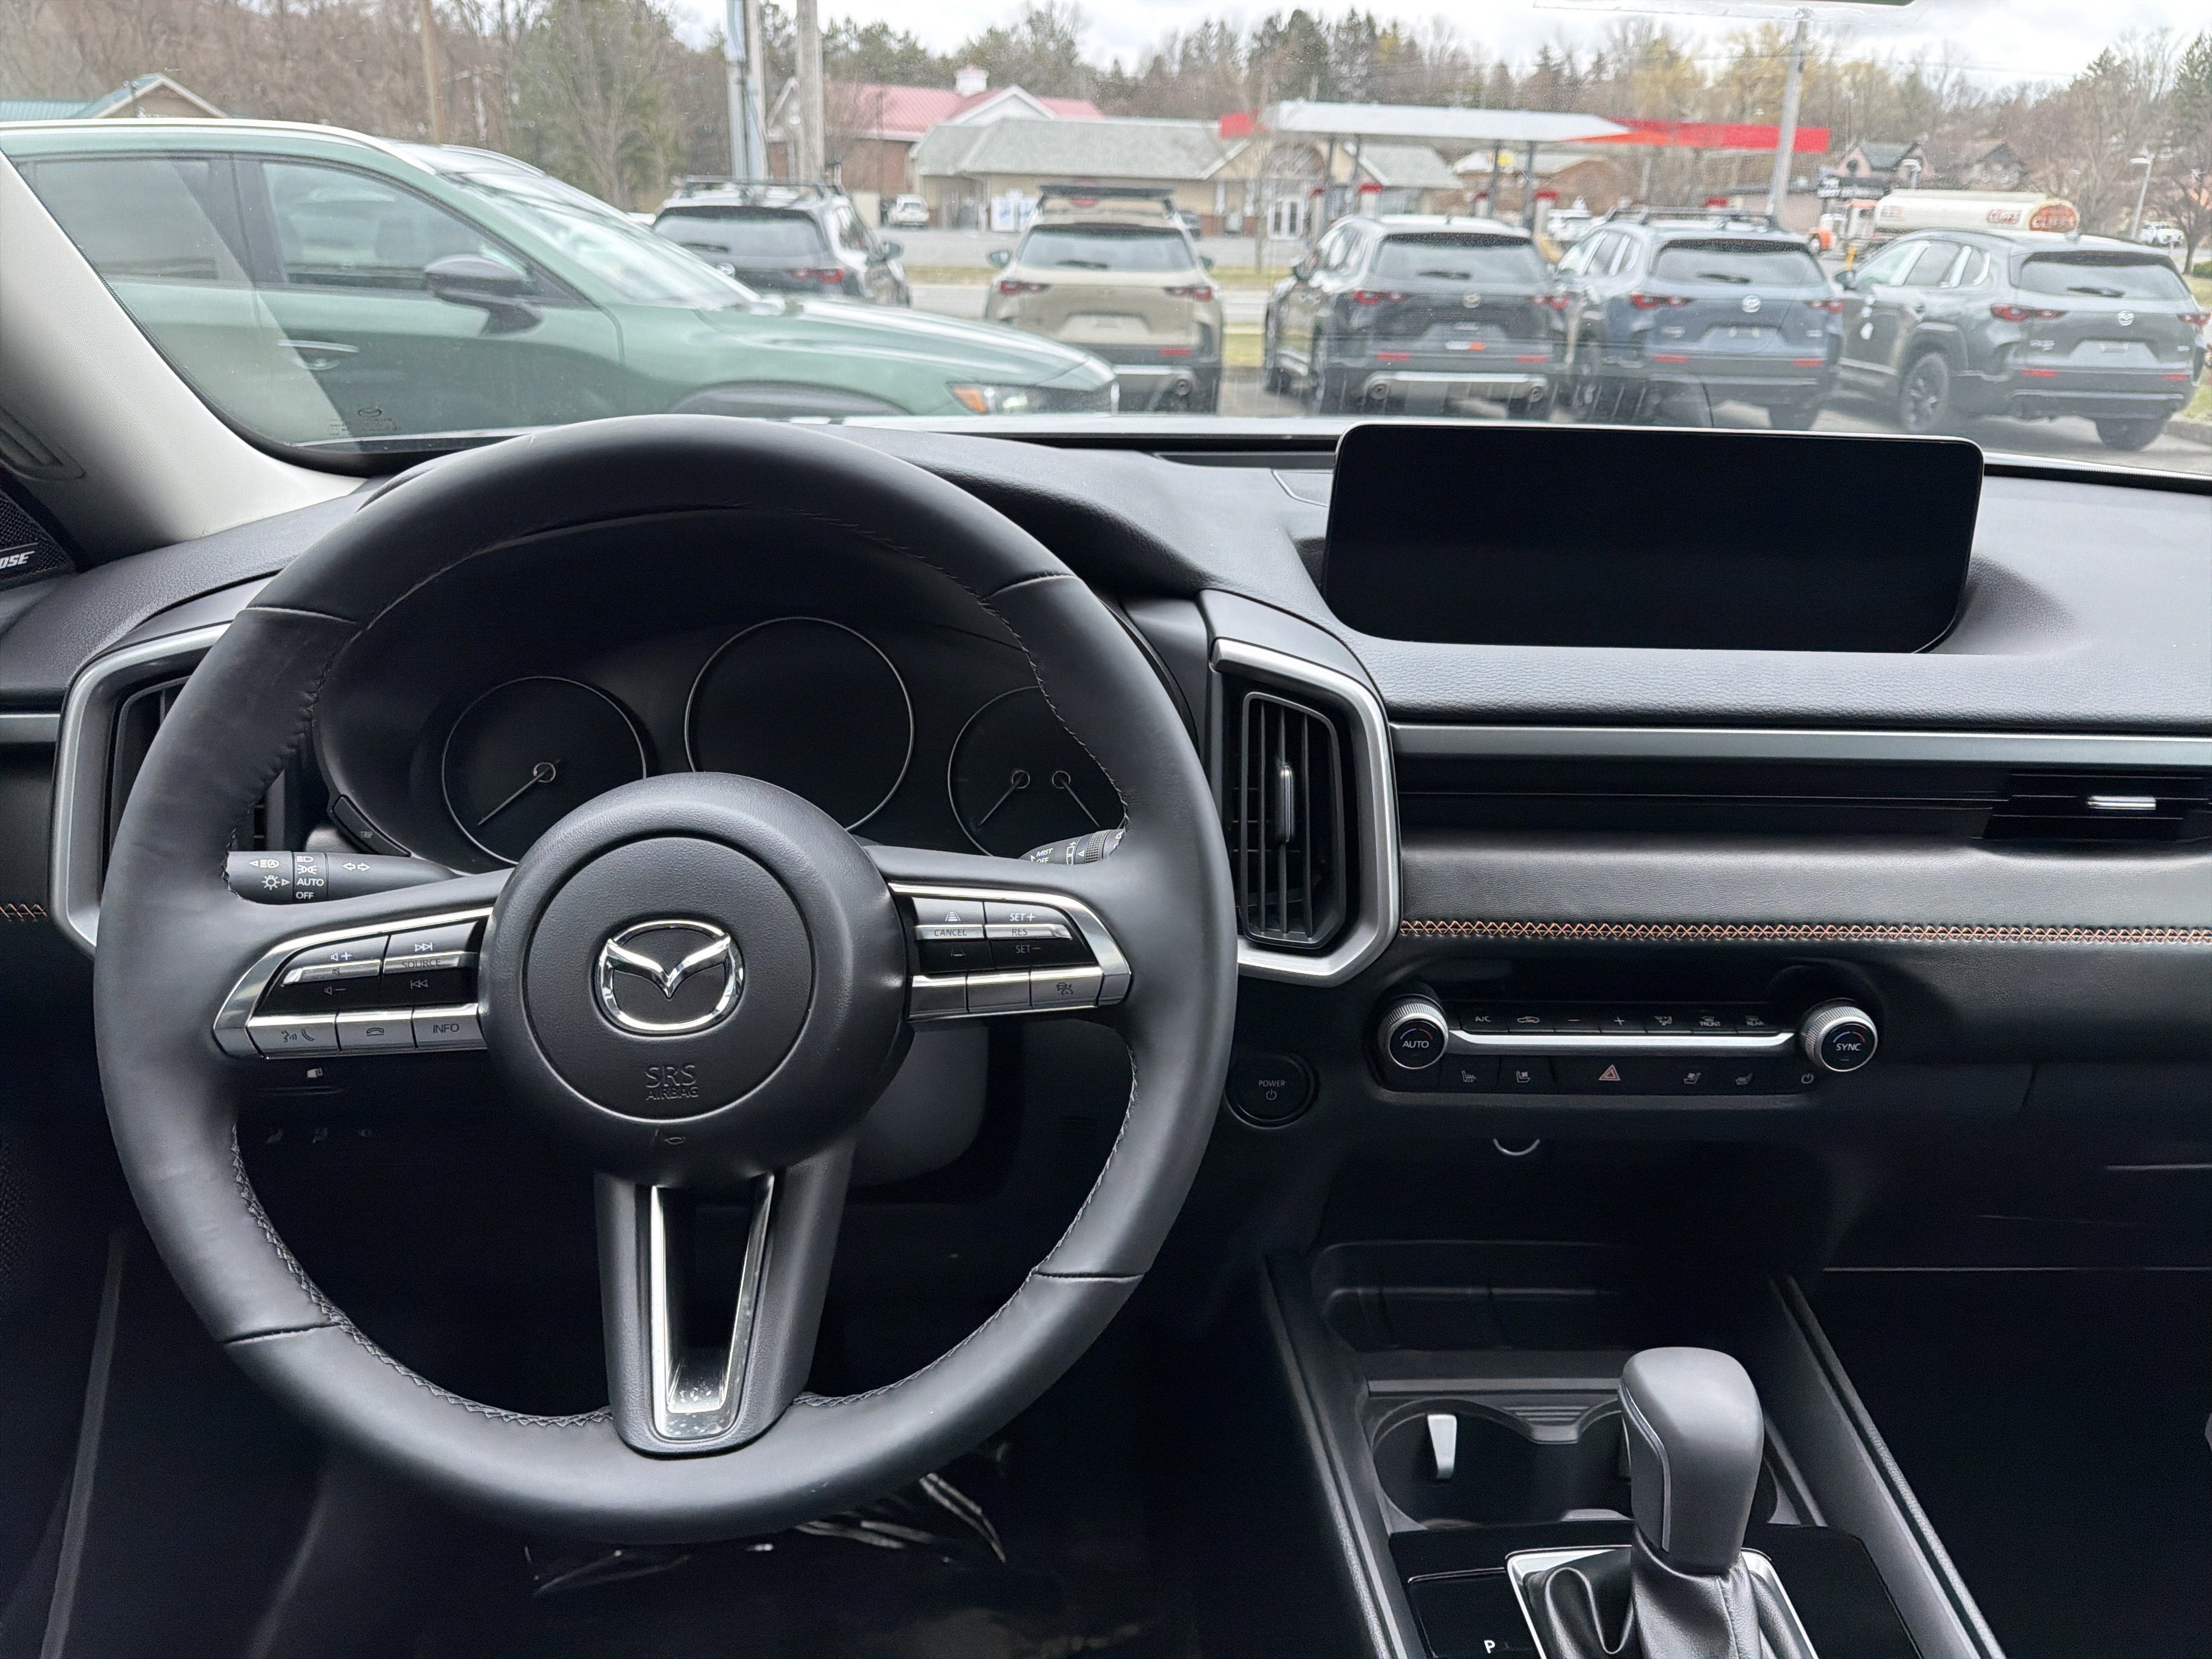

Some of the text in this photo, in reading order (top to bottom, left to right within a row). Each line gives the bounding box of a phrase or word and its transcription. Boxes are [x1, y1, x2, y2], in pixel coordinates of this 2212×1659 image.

[1036, 848, 1053, 857] MIST
[296, 877, 324, 887] AUTO
[296, 891, 314, 900] OFF
[402, 958, 441, 969] SOURCE
[433, 1023, 460, 1034] INFO
[1402, 1040, 1430, 1048] AUTO
[1836, 1043, 1862, 1051] SYNC
[644, 1064, 697, 1088] SRS
[645, 1086, 699, 1101] AIRBAG
[1483, 1640, 1496, 1654] P
